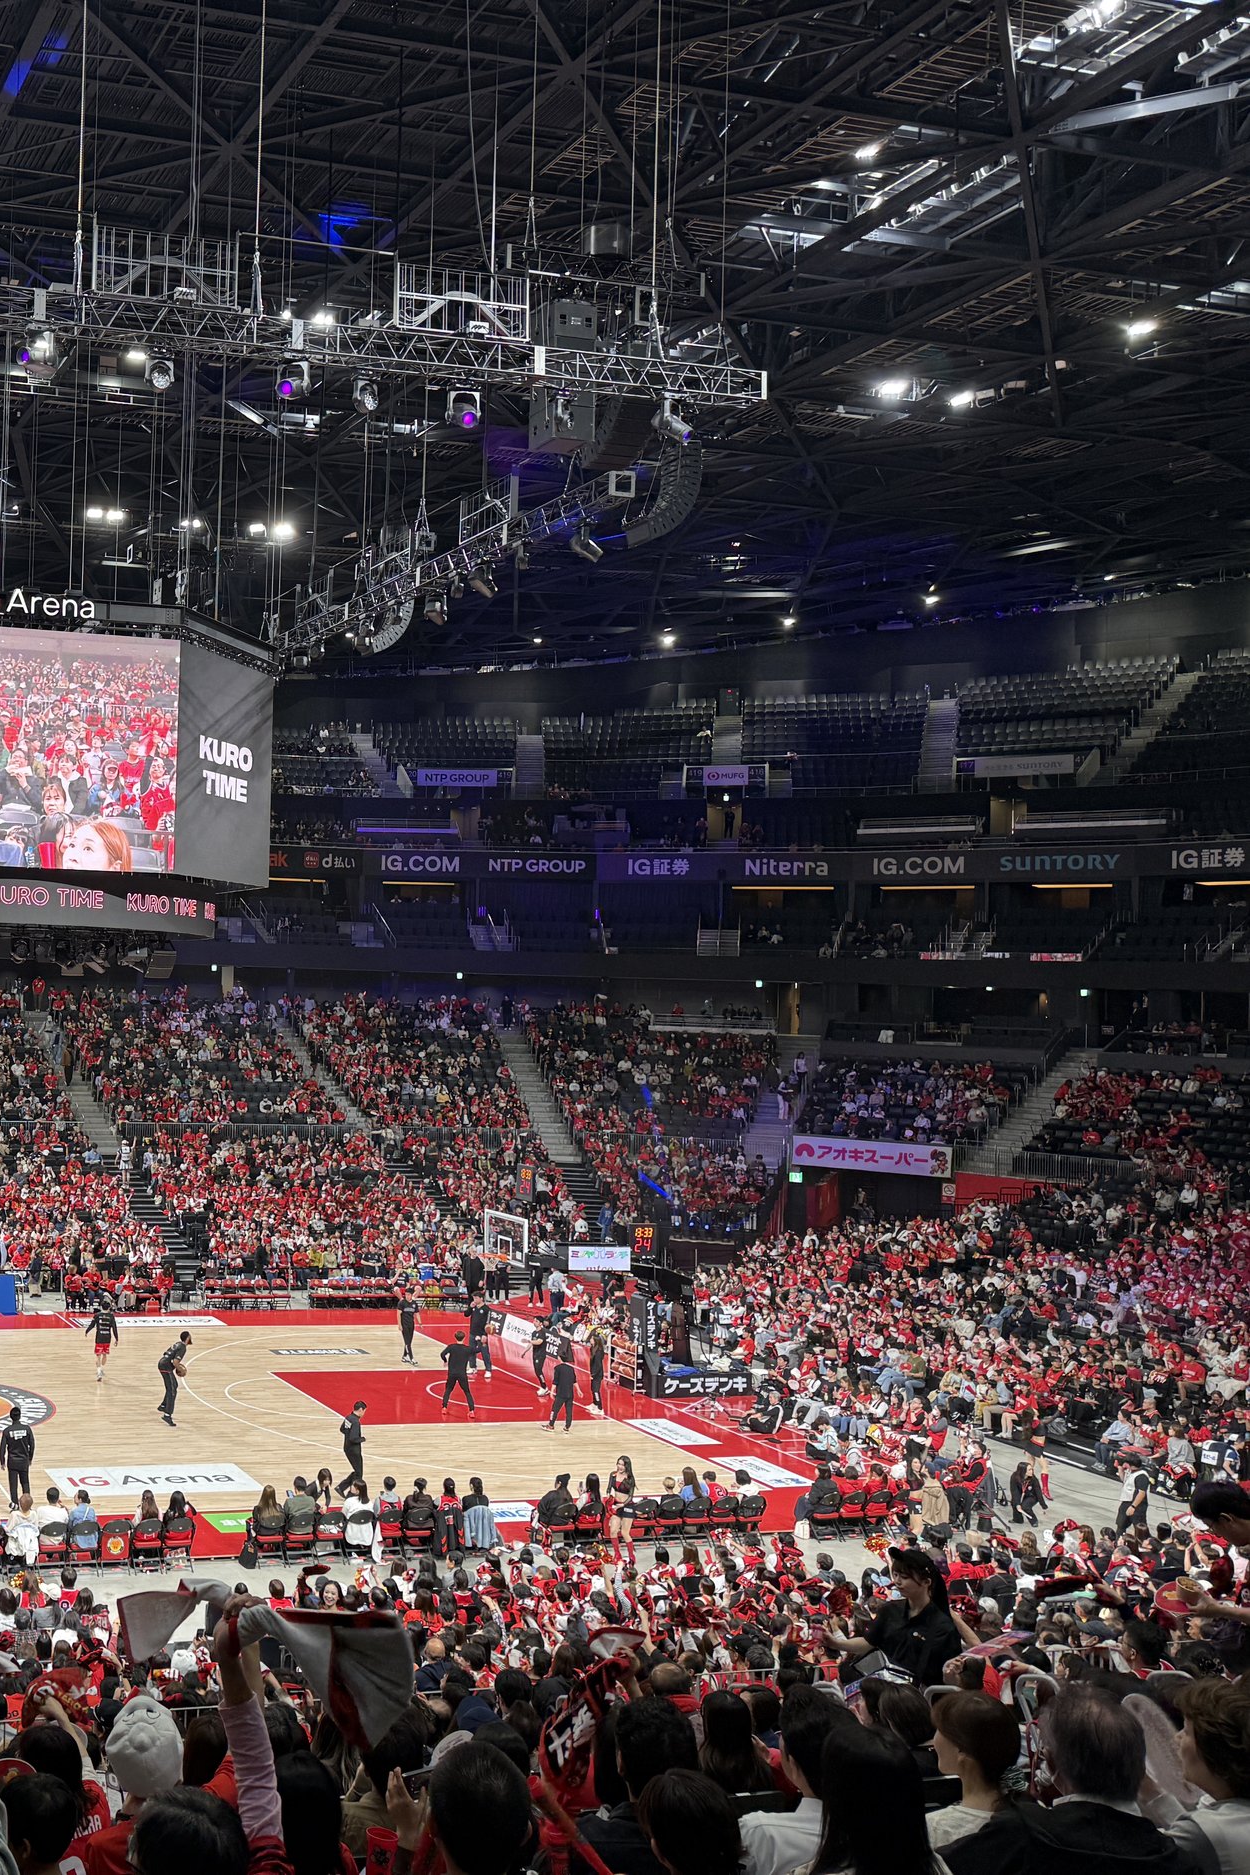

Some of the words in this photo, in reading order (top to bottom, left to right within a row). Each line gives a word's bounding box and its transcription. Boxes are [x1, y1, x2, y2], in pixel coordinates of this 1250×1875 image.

[6, 588, 95, 619] Arena
[199, 734, 253, 772] KURO
[202, 769, 248, 803] TIME
[424, 773, 448, 782] NTP
[449, 773, 490, 783] GROUP
[322, 853, 355, 868] d払い
[381, 855, 460, 873] IG.COM
[488, 859, 523, 873] NTP
[525, 860, 586, 874] GROUP
[627, 857, 690, 876] IG証券
[744, 858, 829, 876] Niterra
[873, 857, 965, 875] IG.COM
[1171, 848, 1246, 870] IG証券
[56, 888, 104, 909] TIME
[126, 893, 170, 914] KURO
[173, 897, 197, 918] TIME
[817, 1145, 928, 1167] アオキスーパー
[635, 1238, 651, 1253] 24
[646, 1301, 656, 1349] ケーズデンキ
[664, 1376, 747, 1395] ケーズデンキ
[67, 1475, 111, 1488] IG
[122, 1473, 235, 1486] Arena
